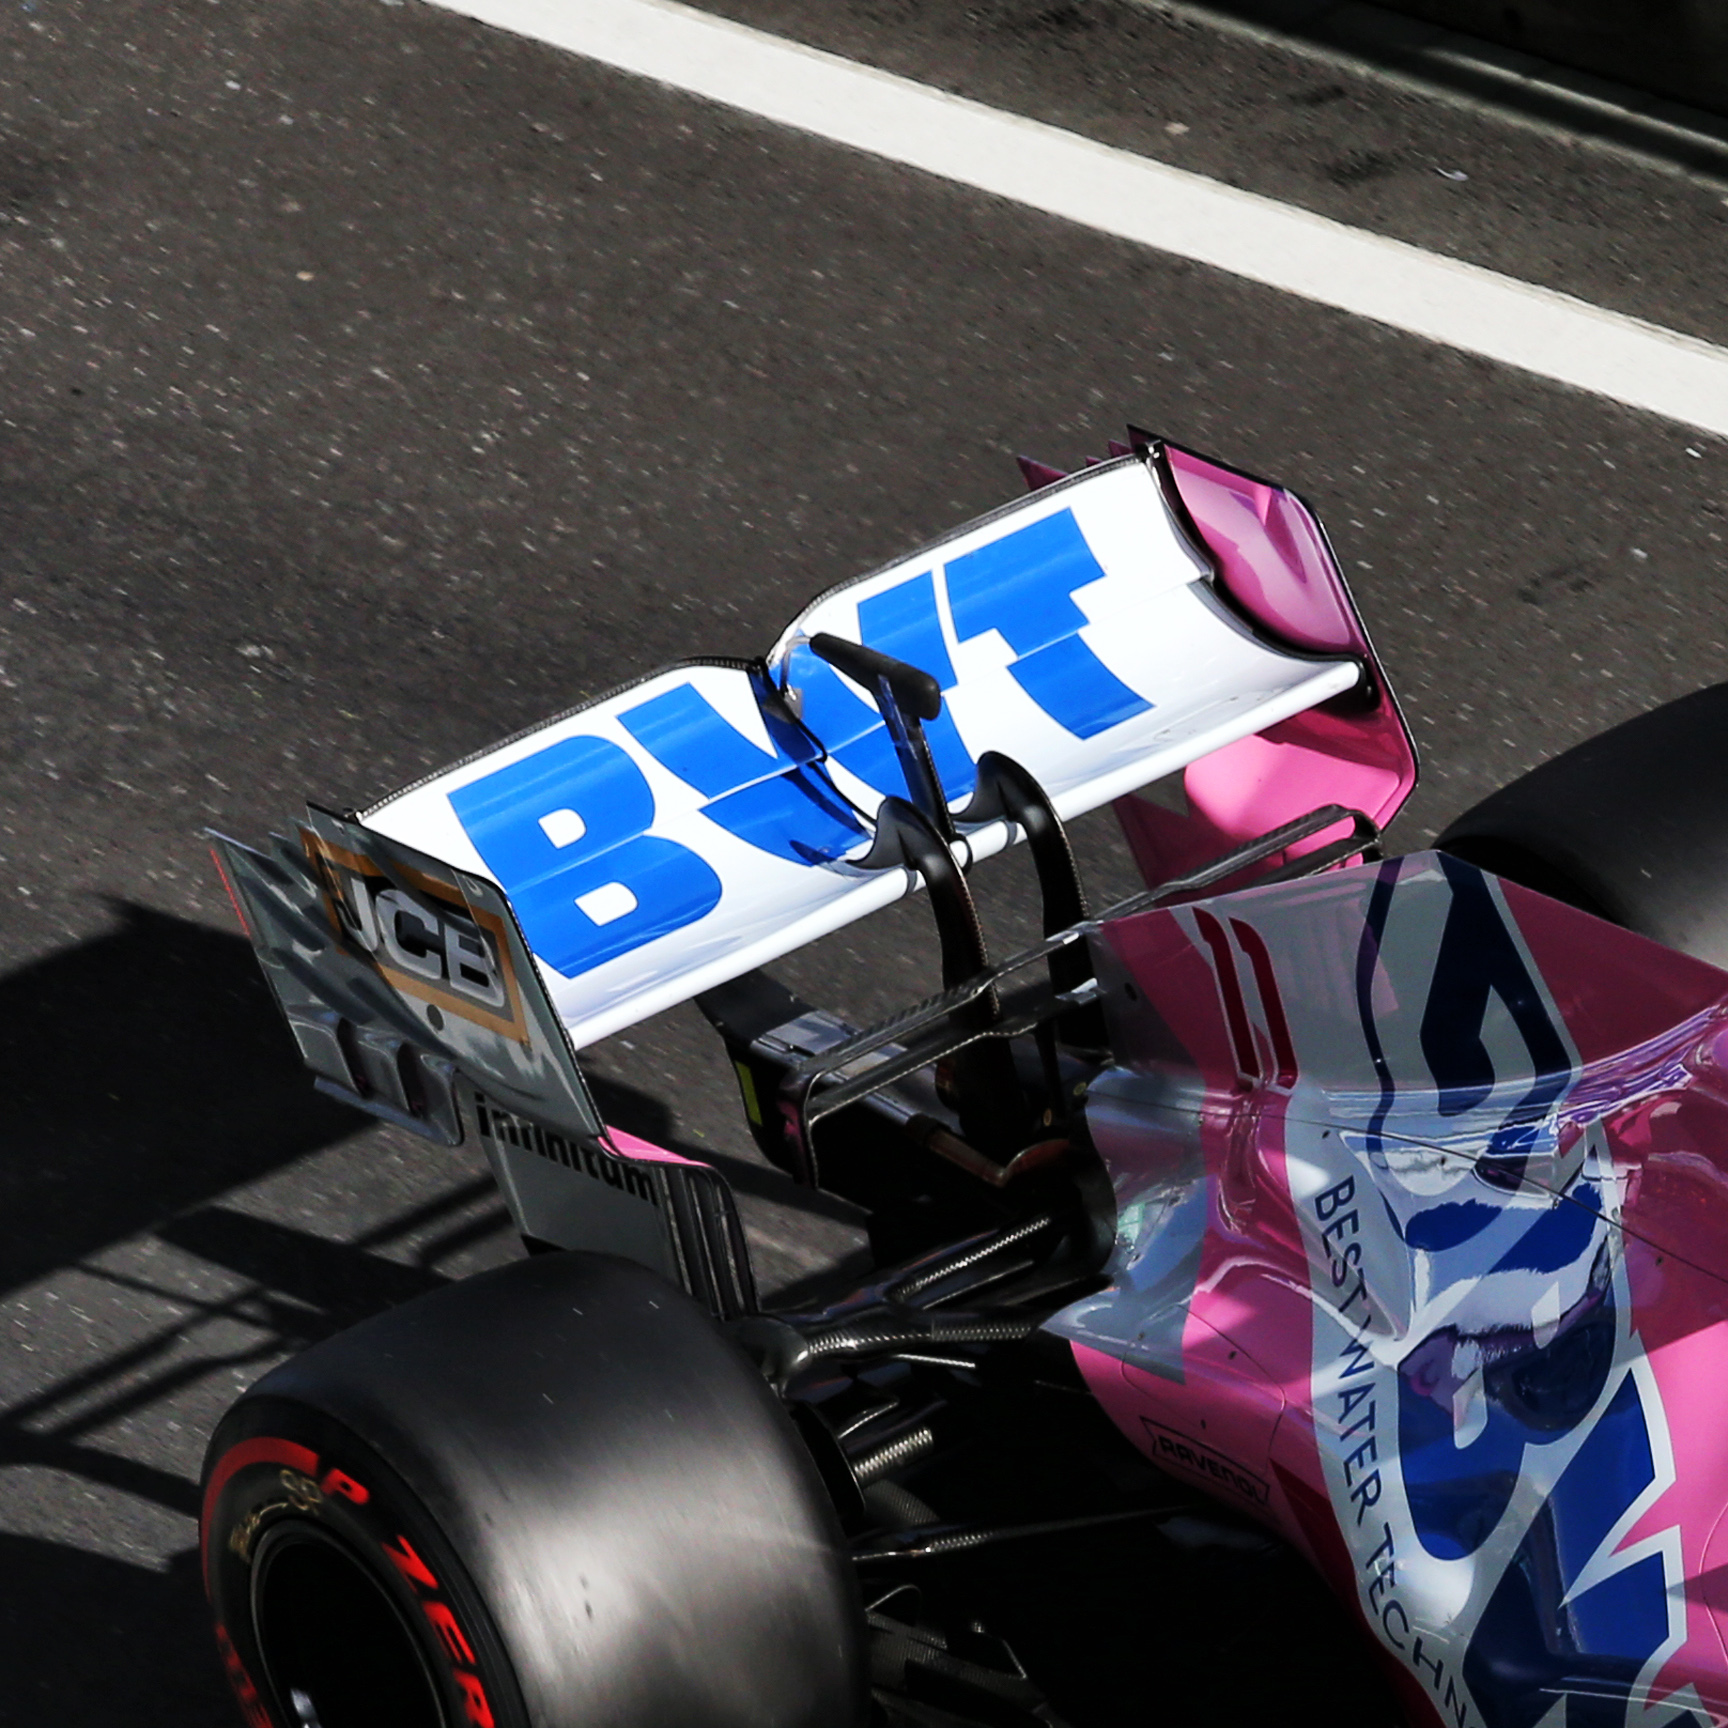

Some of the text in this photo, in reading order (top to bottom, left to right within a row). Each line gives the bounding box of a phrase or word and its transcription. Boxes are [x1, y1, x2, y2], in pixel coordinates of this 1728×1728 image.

[449, 506, 1155, 979] BWT
[335, 876, 505, 1008] JCB
[1192, 905, 1298, 1092] 11
[1314, 1174, 1367, 1313] BEST
[320, 1468, 370, 1504] P
[1158, 1435, 1265, 1504] RAVENOL
[1337, 1314, 1383, 1528] WATER
